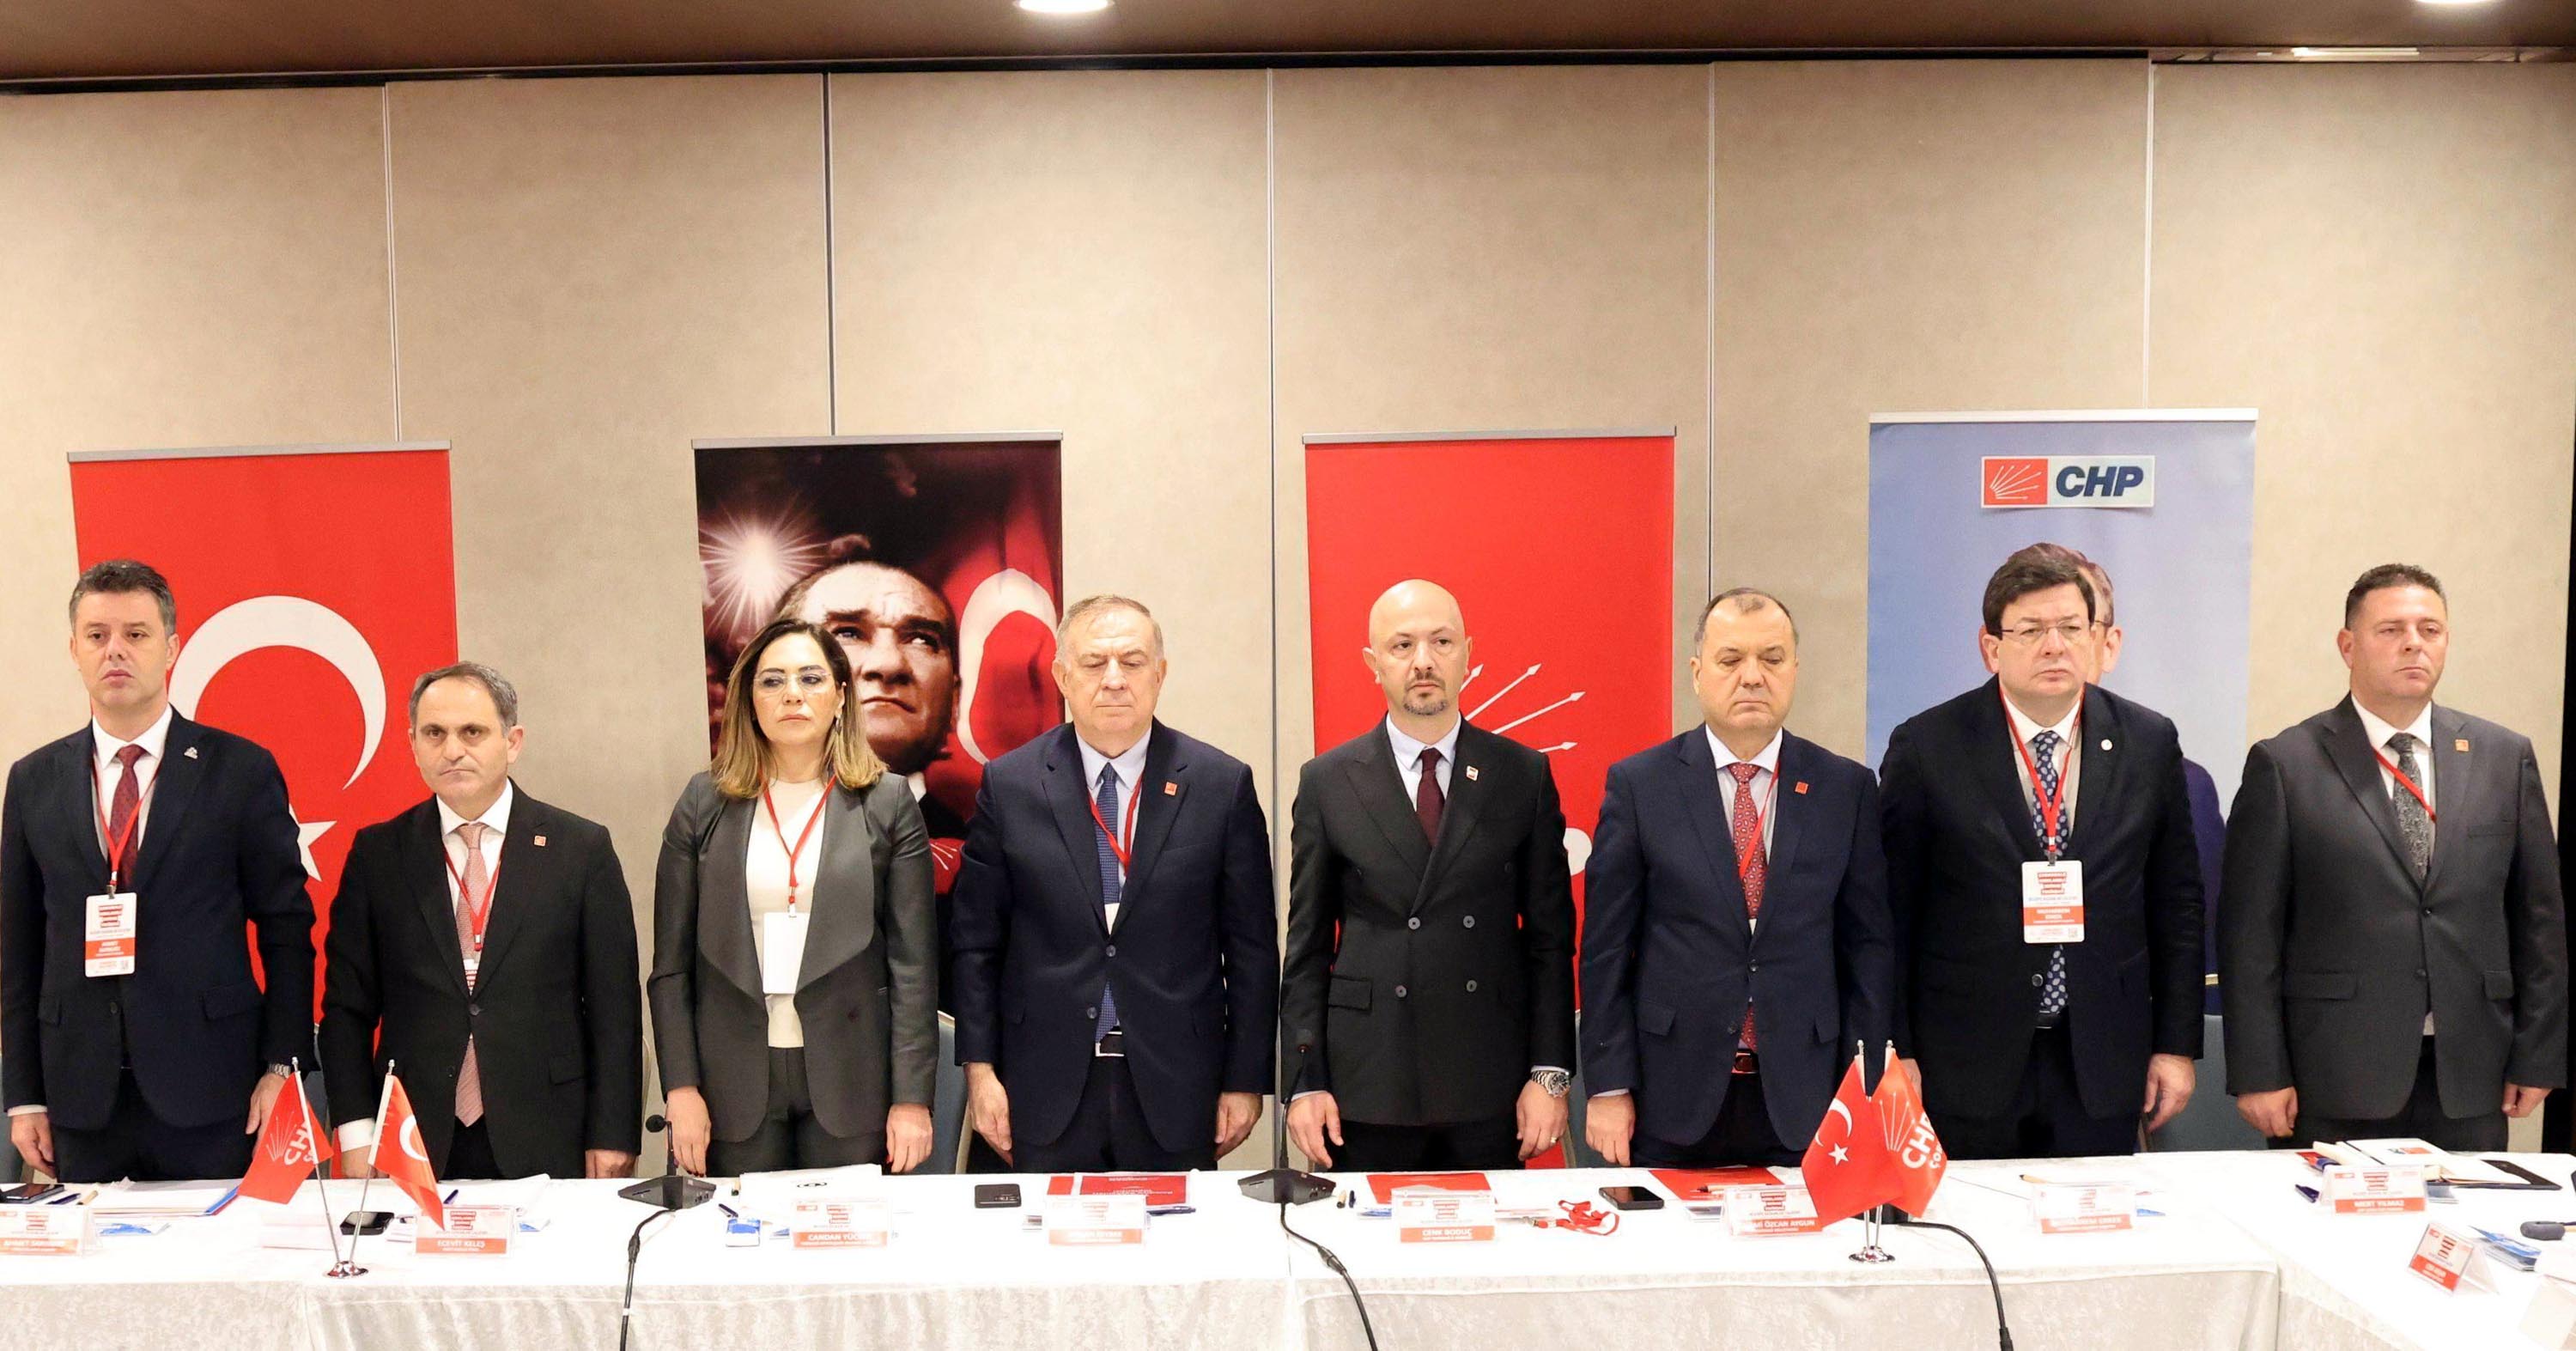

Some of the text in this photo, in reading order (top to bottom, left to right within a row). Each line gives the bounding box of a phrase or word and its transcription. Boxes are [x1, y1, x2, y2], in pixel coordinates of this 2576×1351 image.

[2056, 466, 2144, 497] CHP
[284, 1121, 308, 1165] CH
[808, 1233, 841, 1242] CANDAN
